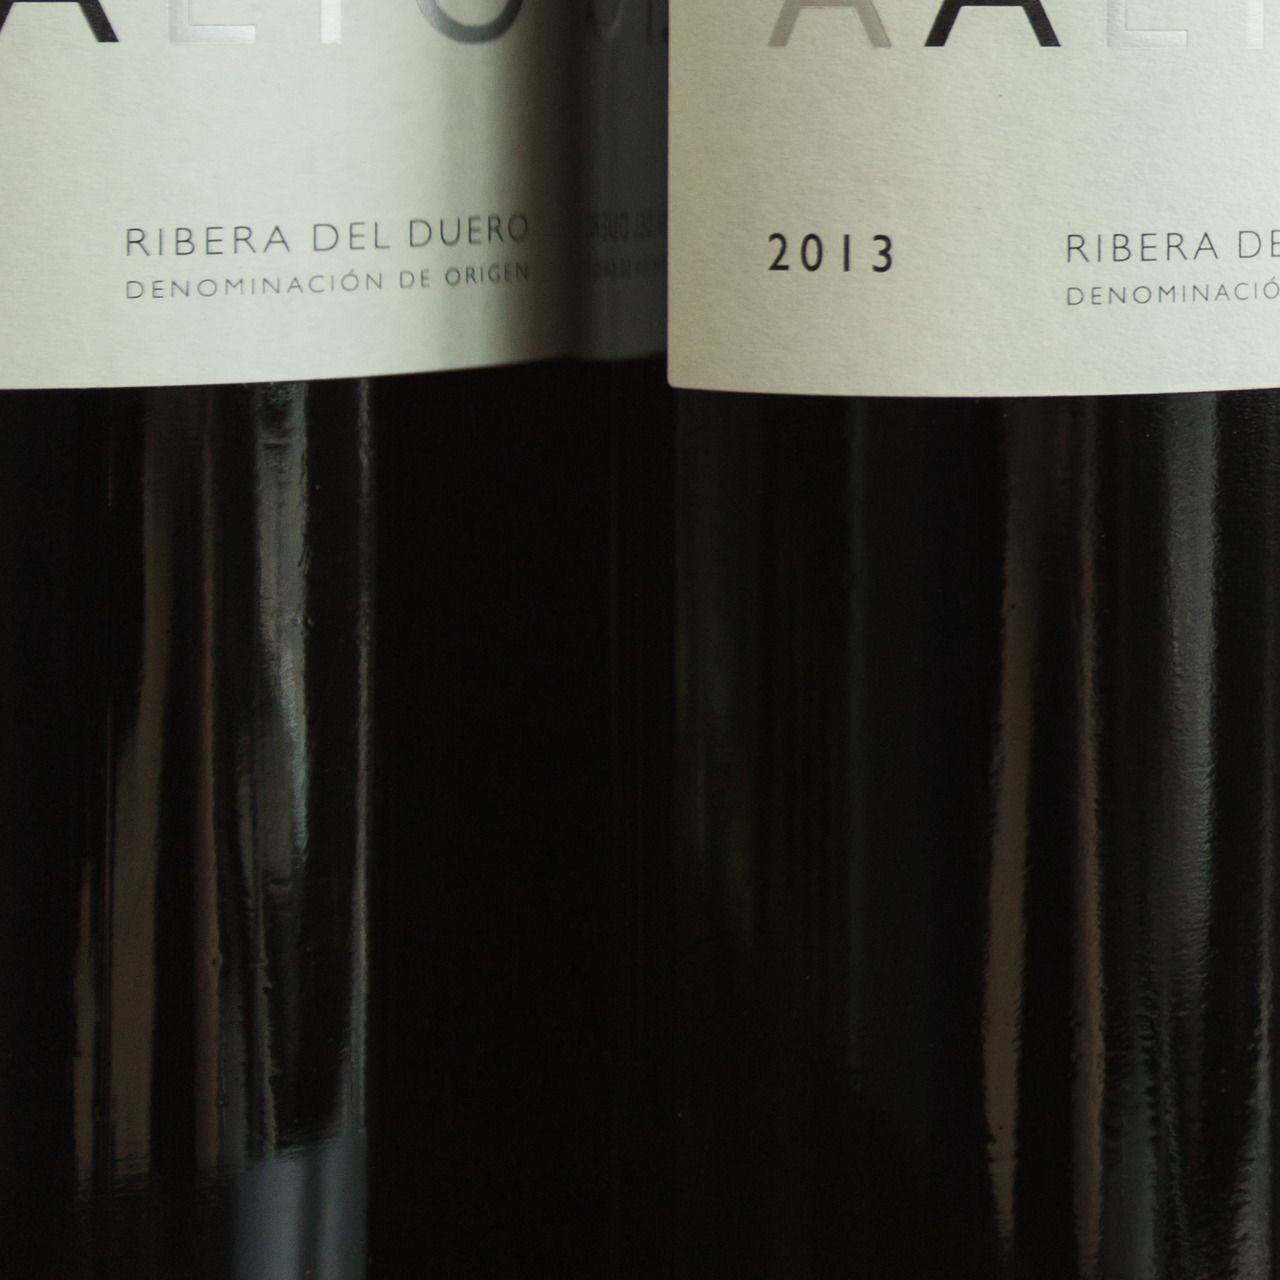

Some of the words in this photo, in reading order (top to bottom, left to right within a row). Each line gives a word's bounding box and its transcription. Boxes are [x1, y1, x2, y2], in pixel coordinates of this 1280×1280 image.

[125, 225, 291, 257] RIBERA
[312, 222, 391, 253] DEL
[409, 213, 530, 249] DUERO
[767, 233, 894, 273] 2013
[1066, 229, 1219, 264] RIBERA
[125, 268, 383, 300] DENOMINACIÓN
[399, 268, 431, 290] DE
[444, 262, 530, 287] ORIGEN
